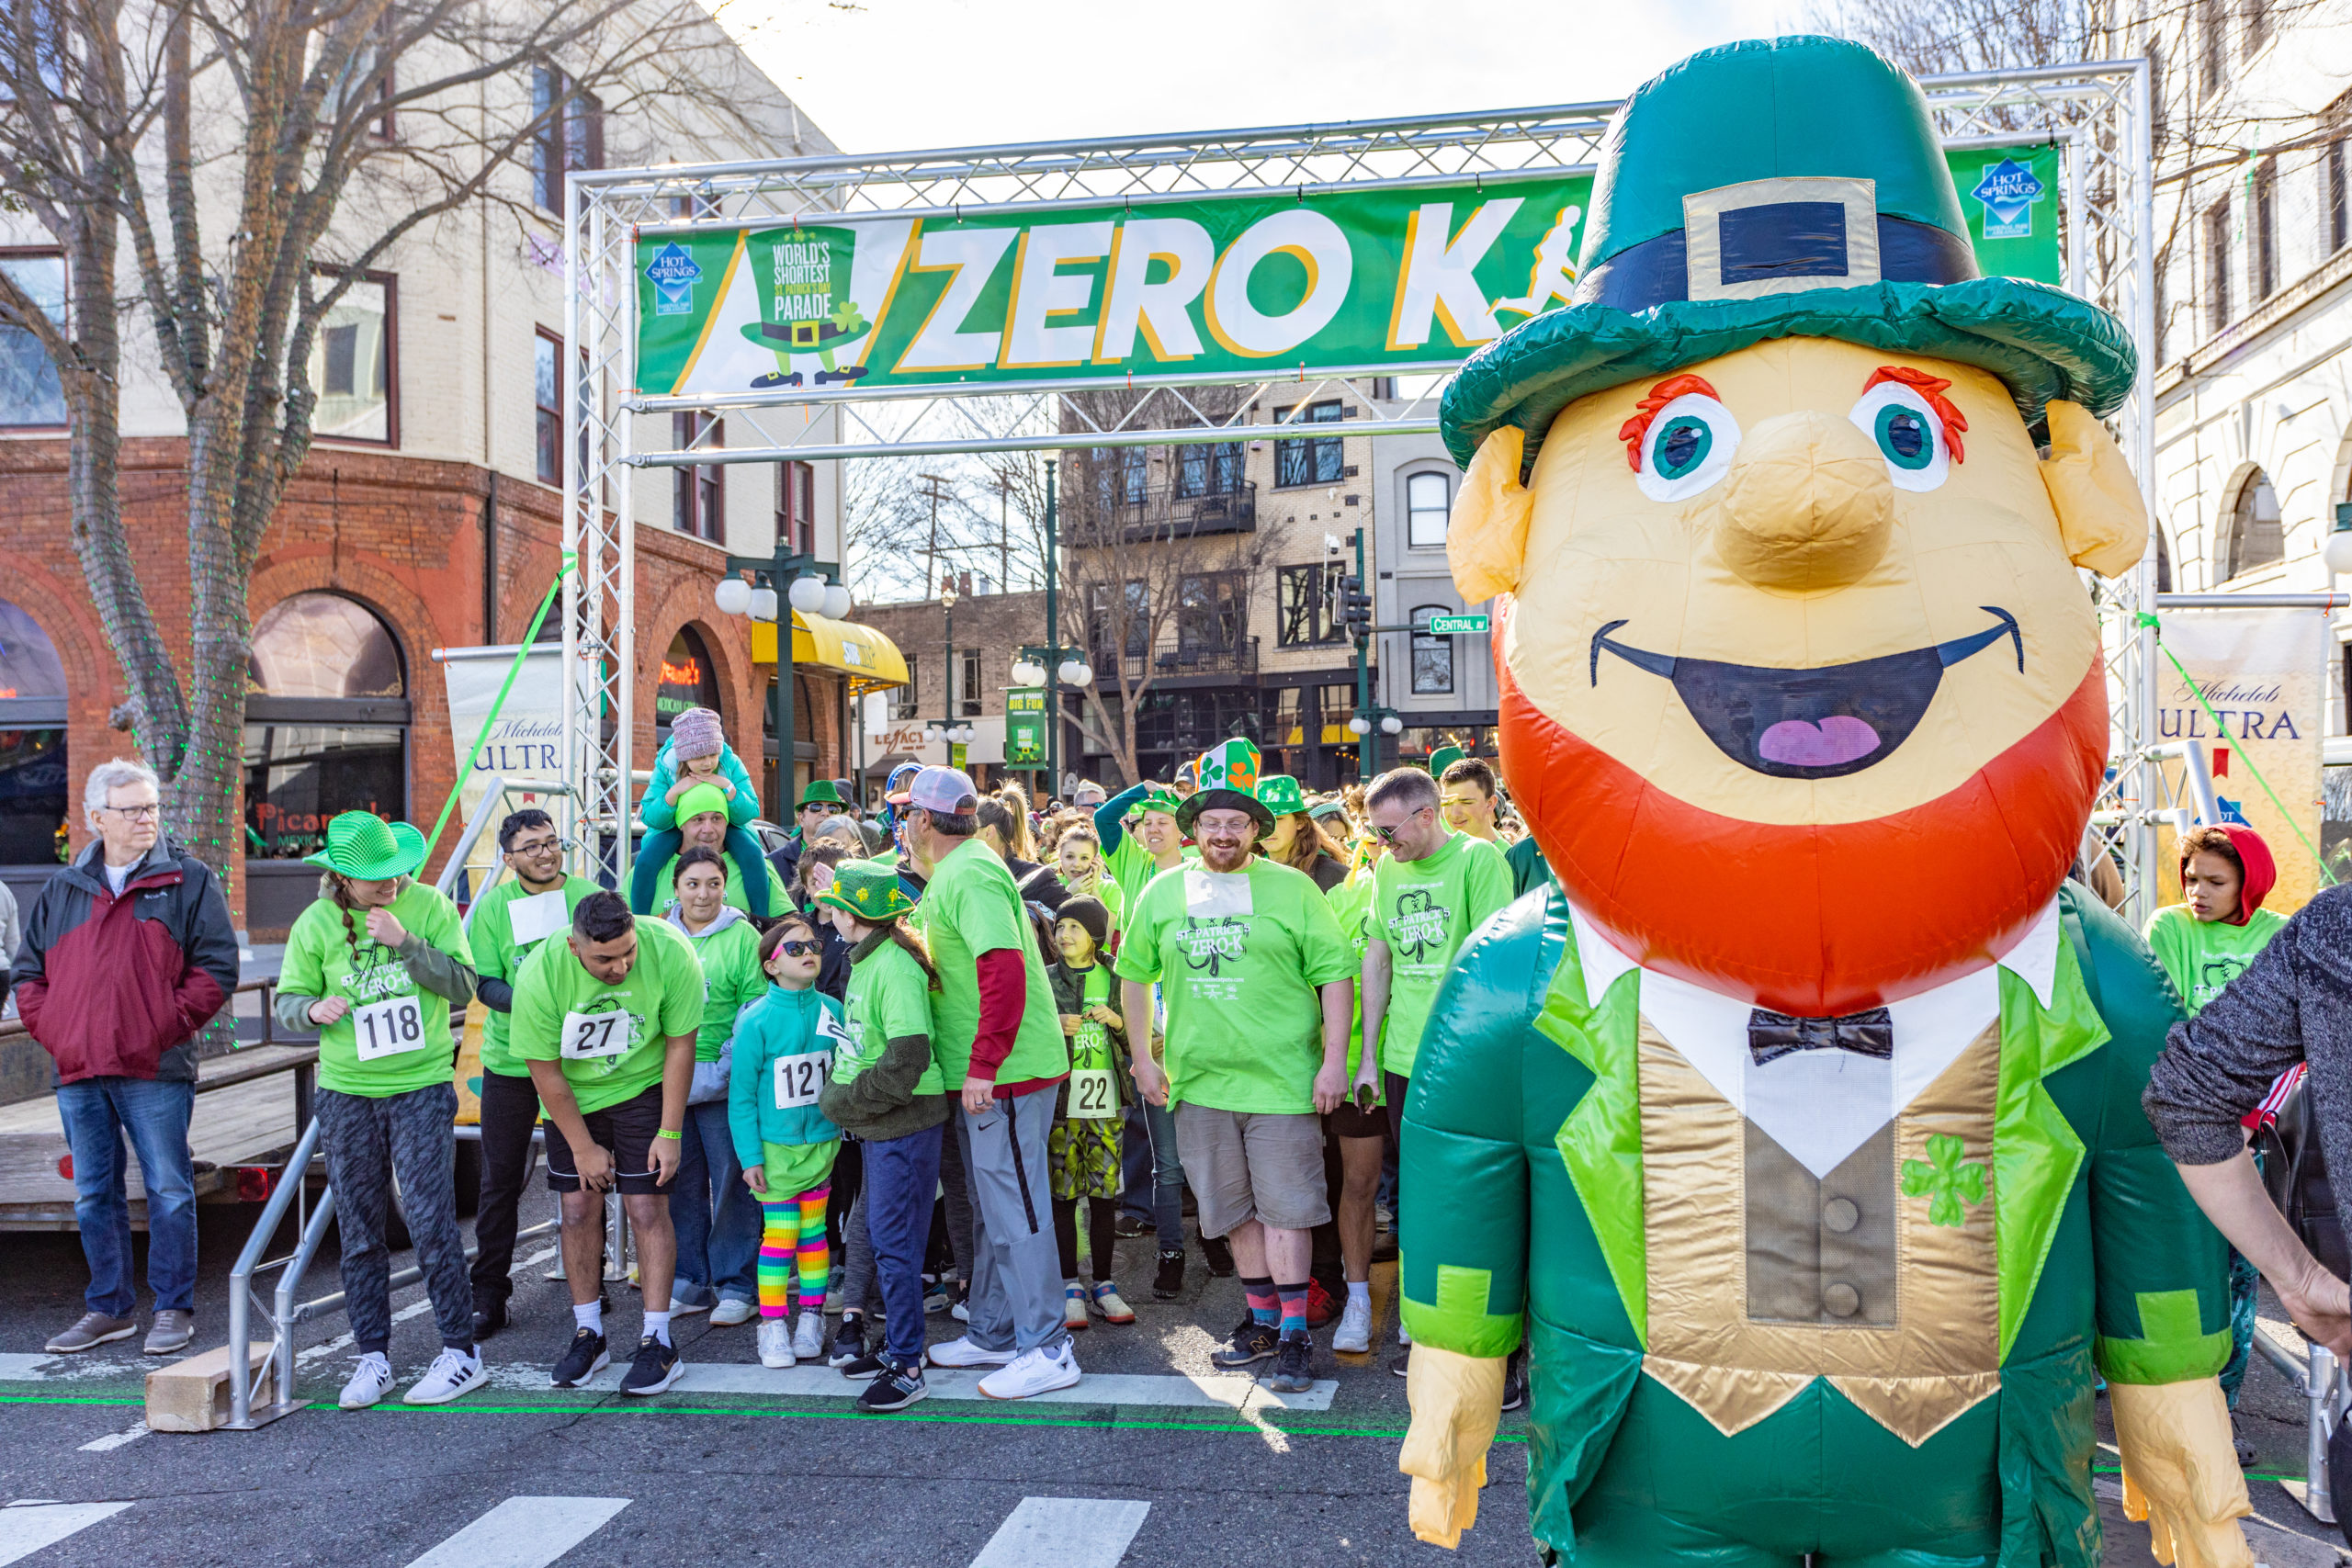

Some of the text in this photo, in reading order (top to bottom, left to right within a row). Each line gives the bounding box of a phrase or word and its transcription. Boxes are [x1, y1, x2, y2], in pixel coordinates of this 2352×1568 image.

[1981, 182, 2036, 198] SPRINGS
[1993, 172, 2024, 186] HOT
[661, 256, 685, 267] HOT
[773, 242, 831, 266] WORLD'S
[651, 265, 695, 278] SPRINGS
[774, 264, 831, 285] SHORTEST
[786, 282, 818, 295] PATRICK'S
[819, 282, 831, 294] DAY
[895, 197, 1526, 372] ZERO K
[775, 293, 832, 321] PARADE
[1434, 618, 1473, 631] CENTRAL
[842, 639, 876, 669] SUBWAY
[2174, 679, 2282, 703] Michelob
[1008, 698, 1044, 710] BIG FUN
[2159, 708, 2301, 739] ULTRA
[470, 744, 563, 771] ULTR
[1403, 907, 1450, 926] PATRICK'S
[1176, 922, 1250, 942] ST. PATRICK'S
[1399, 920, 1445, 944] ZERO-K
[1189, 934, 1243, 957] ZERO-K
[356, 970, 413, 1000] ZERO-K
[363, 1005, 420, 1049] 118
[577, 1017, 616, 1052] 27
[782, 1057, 827, 1099] 121
[1080, 1077, 1107, 1111] 22
